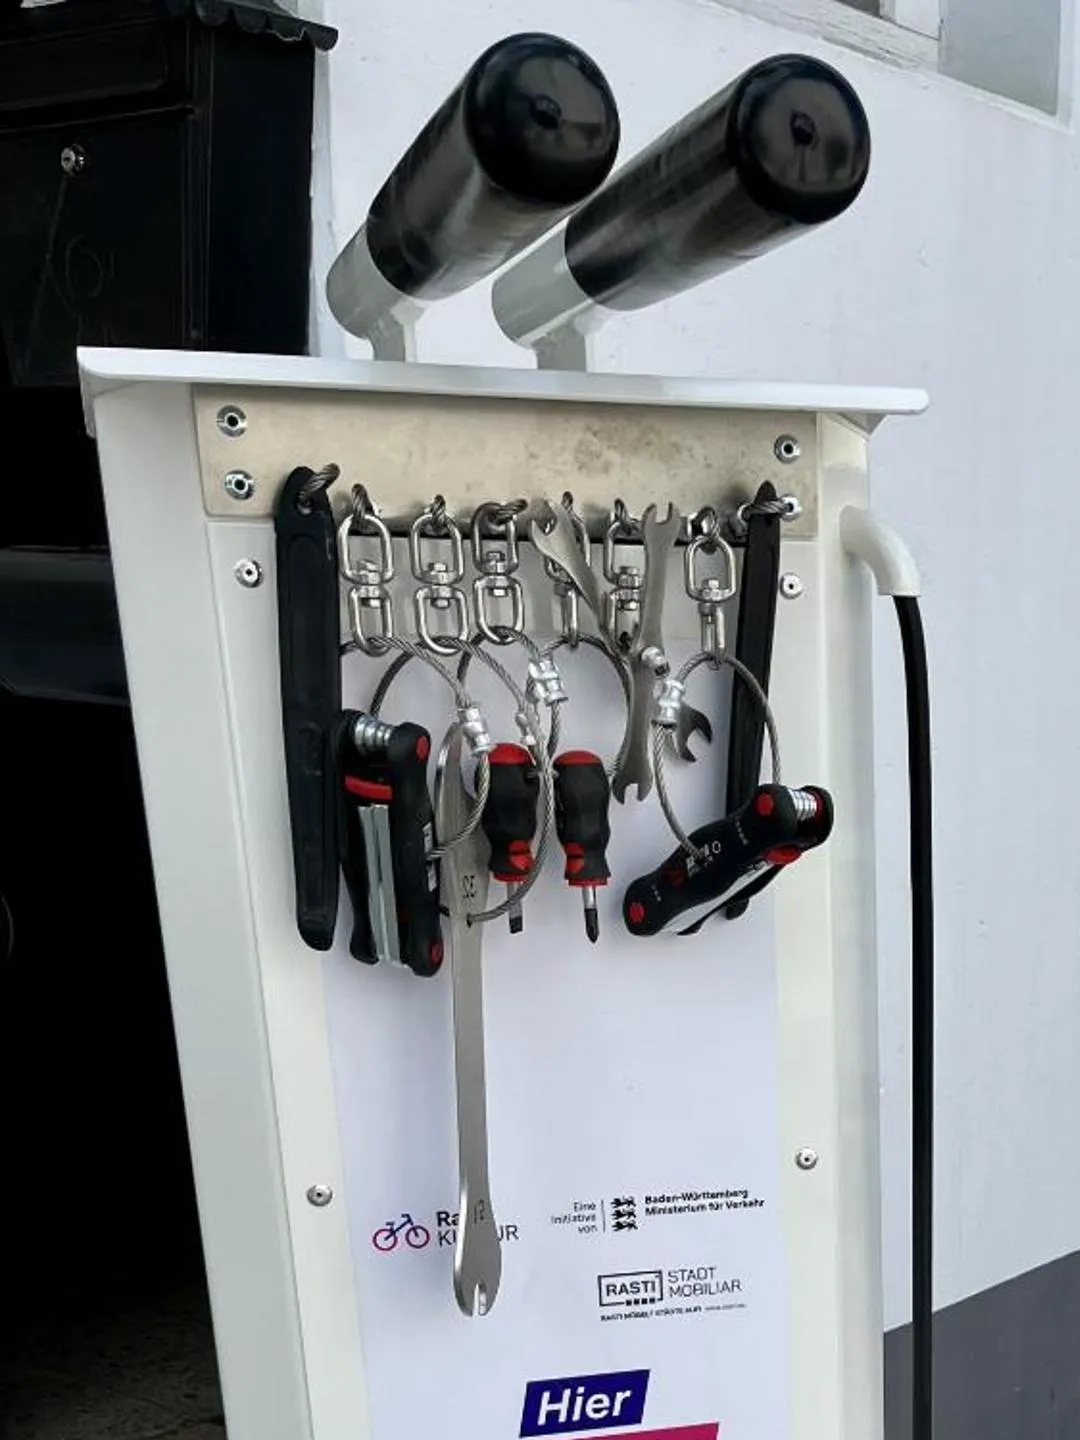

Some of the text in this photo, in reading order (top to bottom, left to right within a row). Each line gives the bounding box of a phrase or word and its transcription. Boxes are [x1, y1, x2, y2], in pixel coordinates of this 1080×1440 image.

[645, 1189, 749, 1204] Baden-Württemberg
[573, 1201, 597, 1213] Eine
[645, 1198, 766, 1216] Ministerium für Verkehr
[436, 1210, 461, 1228] Ra
[577, 1224, 599, 1234] von
[668, 1266, 717, 1284] STADT
[606, 1280, 657, 1297] RASTI
[669, 1279, 743, 1298] MOBILIAR
[537, 1386, 632, 1426] Hier
